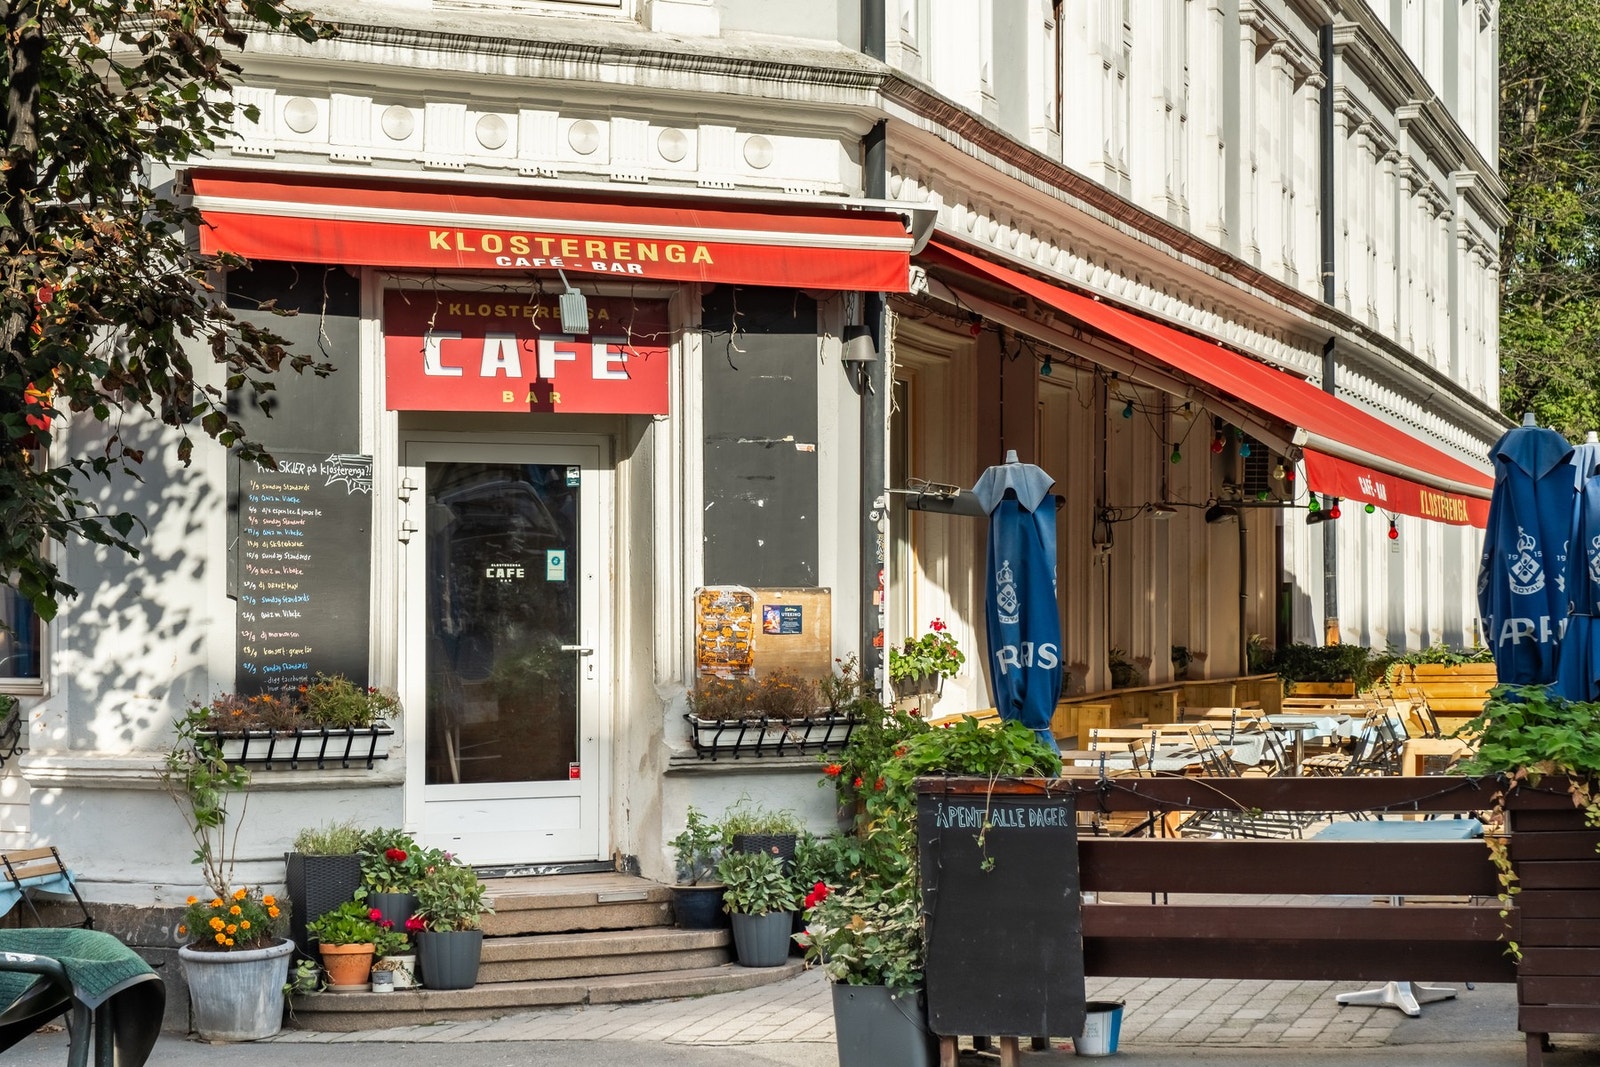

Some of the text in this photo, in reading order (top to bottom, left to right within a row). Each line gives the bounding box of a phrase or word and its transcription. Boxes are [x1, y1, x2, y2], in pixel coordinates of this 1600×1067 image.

[429, 231, 714, 265] KLOSTERENGA
[495, 255, 565, 269] CAFÉ
[593, 261, 644, 275] BAR
[450, 303, 610, 321] KLOSTEREGA
[424, 331, 629, 380] CAFE
[502, 391, 562, 404] BAR
[278, 461, 306, 475] SKJER
[307, 465, 317, 476] på
[1420, 489, 1469, 522] KLOSTERENGA
[486, 568, 525, 578] CAFE
[934, 803, 1068, 828] ÅPENT ALLE DAGER
